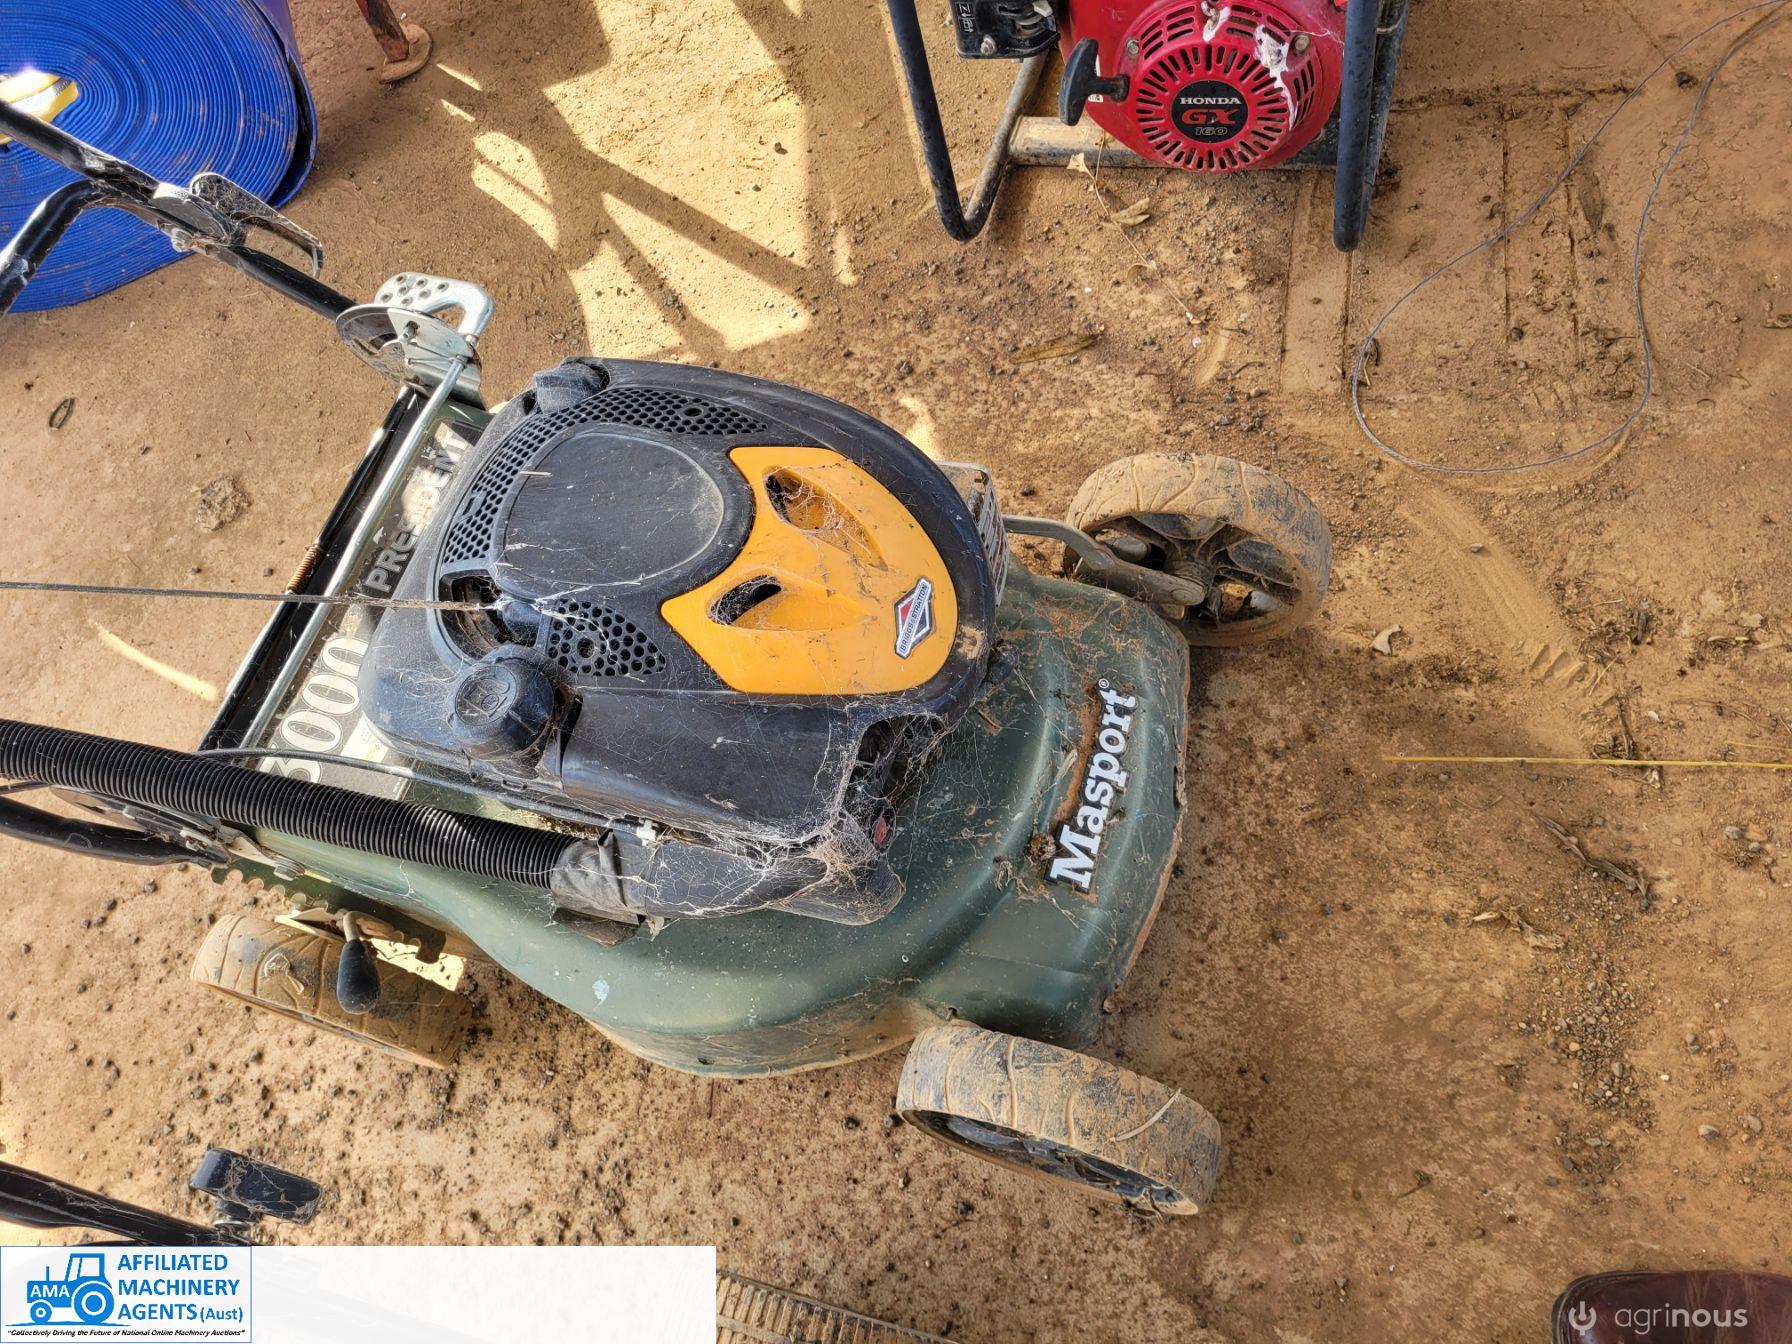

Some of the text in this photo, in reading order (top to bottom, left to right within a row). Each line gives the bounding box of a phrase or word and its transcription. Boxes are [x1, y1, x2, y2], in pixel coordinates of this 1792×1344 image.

[1180, 97, 1242, 105] HONDA
[1181, 108, 1239, 125] GX
[1195, 126, 1228, 136] 160
